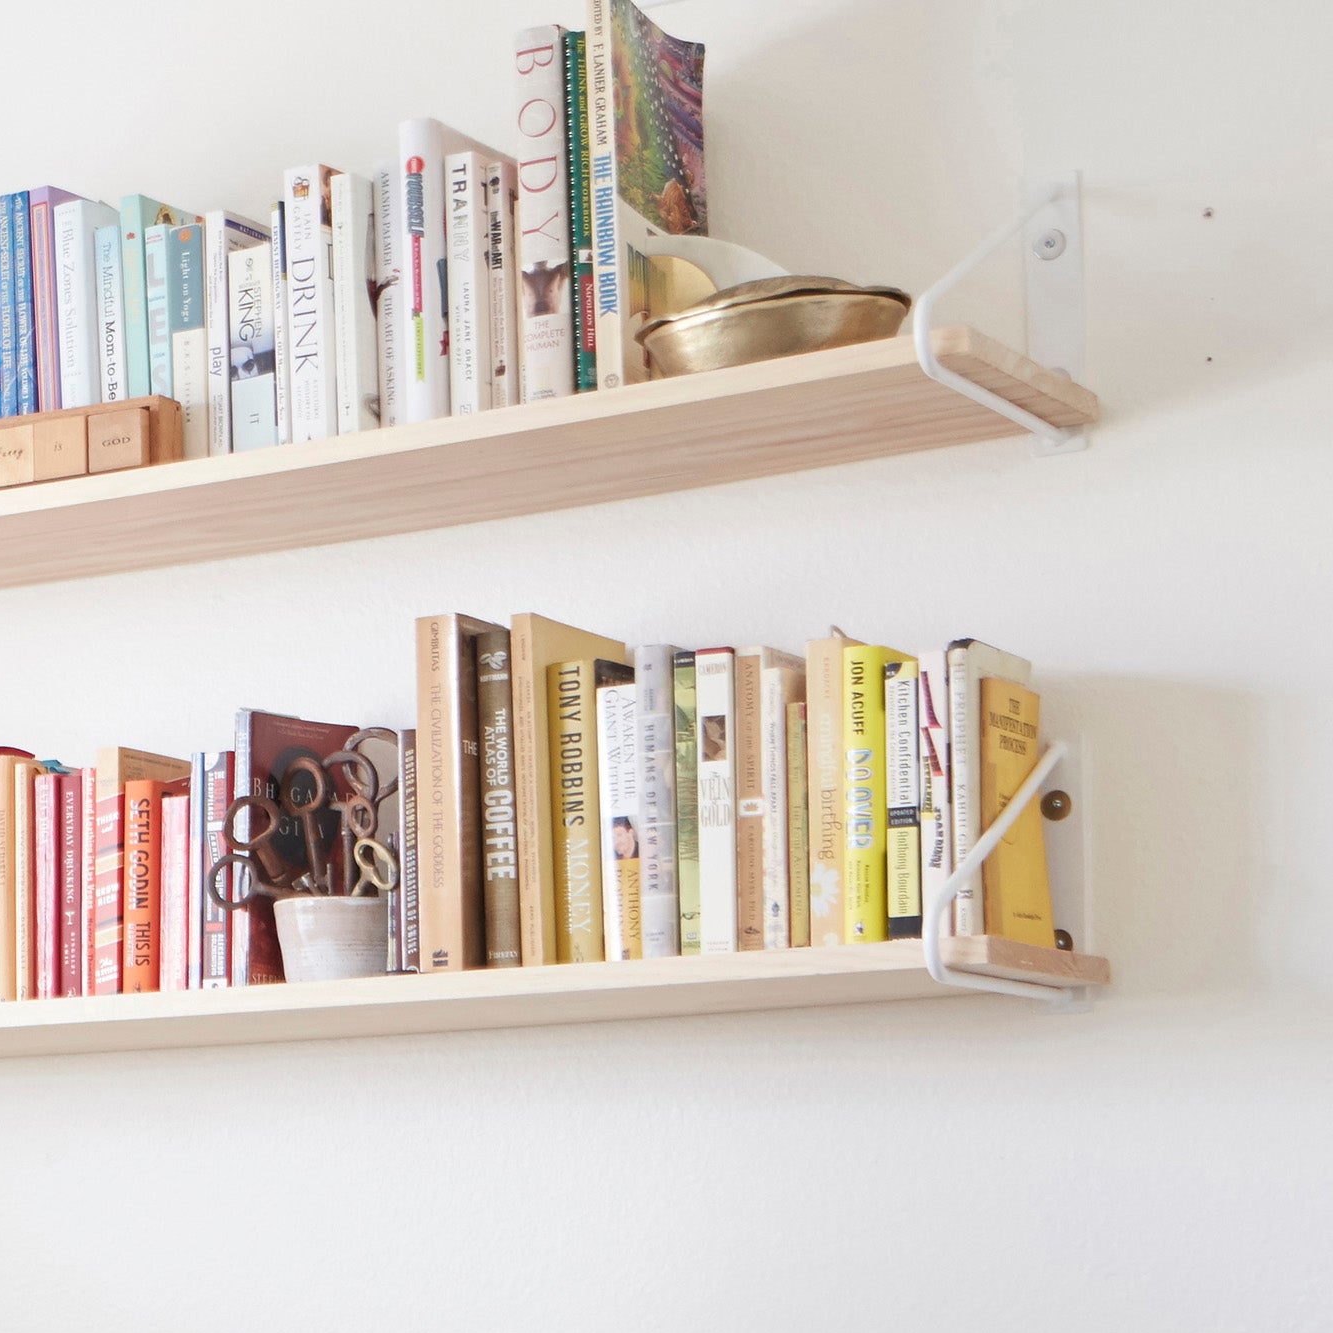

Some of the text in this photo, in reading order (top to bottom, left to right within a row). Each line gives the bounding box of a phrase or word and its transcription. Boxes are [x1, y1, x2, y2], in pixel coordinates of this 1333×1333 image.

[593, 0, 608, 146] DITED LANIER GRAHAM
[516, 44, 560, 242] BODY
[578, 58, 591, 237] THINK GROW RICH WORKBOOK
[15, 213, 25, 247] ANCIENT
[303, 213, 312, 241] IAIN
[381, 172, 392, 266] AMANDA PALMER
[406, 173, 424, 238] YOURSELF
[451, 163, 469, 263] TRANNY
[593, 151, 618, 318] THE RAINBOW BOOK
[0, 214, 12, 338] ANCIENT FLOWER
[61, 228, 78, 368] Blue Zones Solution
[181, 251, 192, 323] Light Yoga
[252, 280, 263, 338] STEPHEN
[102, 242, 119, 401] The Mindful Mom-to-Be
[238, 287, 255, 343] KING
[292, 257, 320, 374] DRINK
[384, 295, 396, 406] THE ART ASKING
[462, 282, 473, 381] LAURA JANE GRACE
[533, 320, 549, 330] THE
[585, 283, 596, 348] NAPOLEON HILL
[209, 346, 222, 377] play
[53, 442, 64, 453] is
[101, 436, 132, 448] GOD
[605, 689, 619, 741] GIANT
[743, 663, 755, 790] ANATOMY SPIRIT
[850, 660, 865, 736] JON ACUFF
[987, 711, 1038, 740] MANIFESTATION
[484, 726, 497, 787] ATLAS OF
[494, 708, 508, 786] THE WORLD
[558, 665, 586, 827] TONY ROBBINS
[621, 697, 637, 800] AWAKEN THE
[644, 724, 657, 783] HUMANS
[846, 748, 873, 782] DO
[897, 680, 912, 805] Kitchen Confidential
[998, 733, 1027, 757] PROCESS
[431, 683, 445, 888] THE CIVILIZATION THE GODDESS
[646, 791, 656, 809] OF
[700, 778, 731, 801] VEIN
[700, 803, 731, 828] GOLD
[846, 787, 874, 850] OVER
[65, 791, 76, 903] EVERYDAY DRINKING
[129, 798, 150, 910] SETH GODIN
[484, 789, 517, 881] COFFEE
[646, 816, 657, 846] NEW
[818, 789, 842, 860] birthing
[406, 849, 417, 908] GENERATION
[570, 838, 592, 933] MONEY
[627, 867, 641, 941] ANTHONY
[646, 854, 659, 891] YORK
[897, 872, 910, 914] Bourdain
[135, 922, 151, 967] THIS IS
